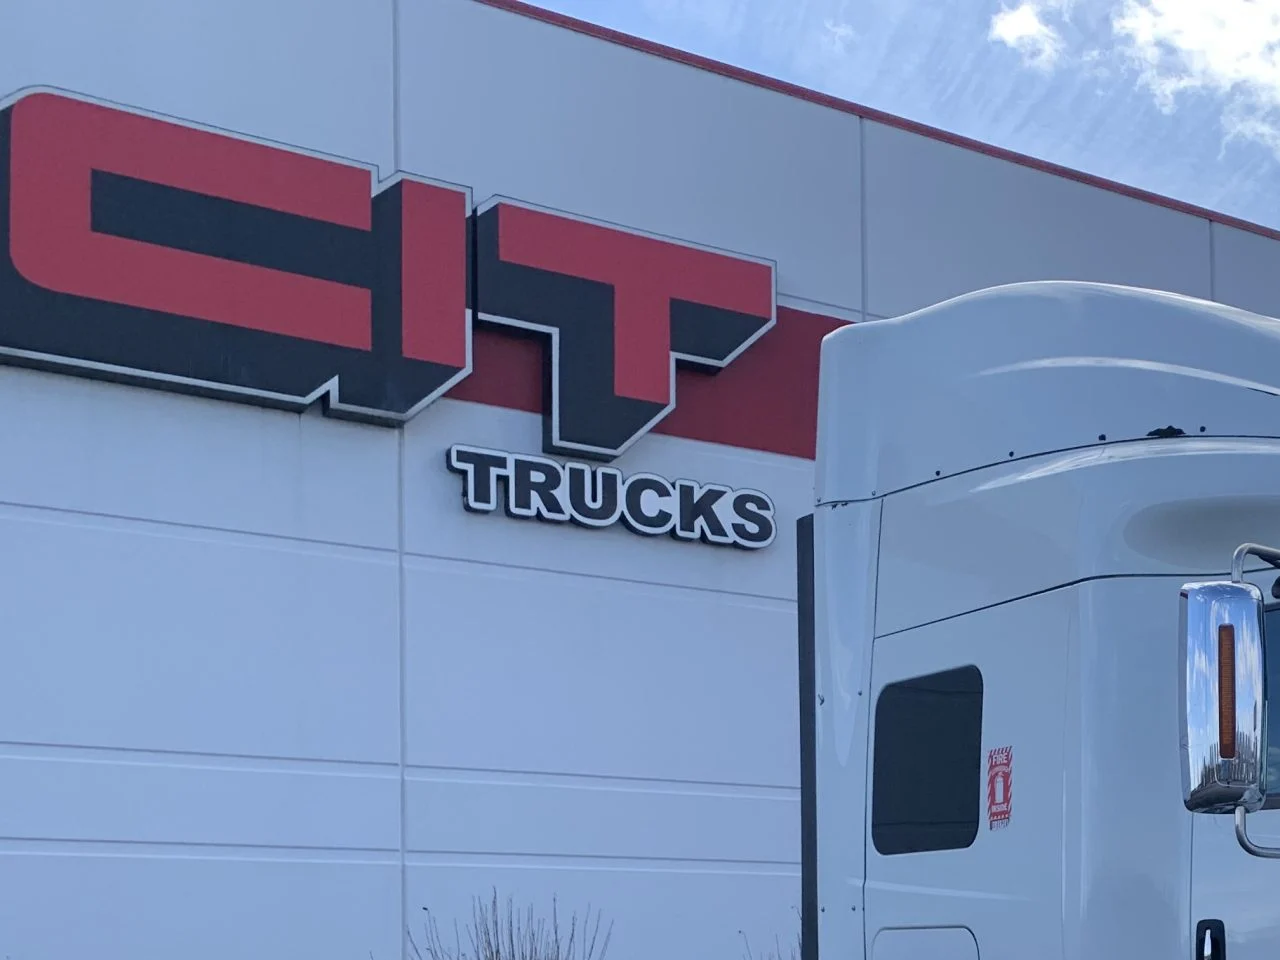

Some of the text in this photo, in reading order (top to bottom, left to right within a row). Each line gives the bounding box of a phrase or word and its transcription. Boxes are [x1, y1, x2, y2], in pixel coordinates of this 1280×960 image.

[4, 89, 776, 456] CIT
[452, 447, 775, 548] TRUCKS
[992, 753, 1008, 765] FIRE
